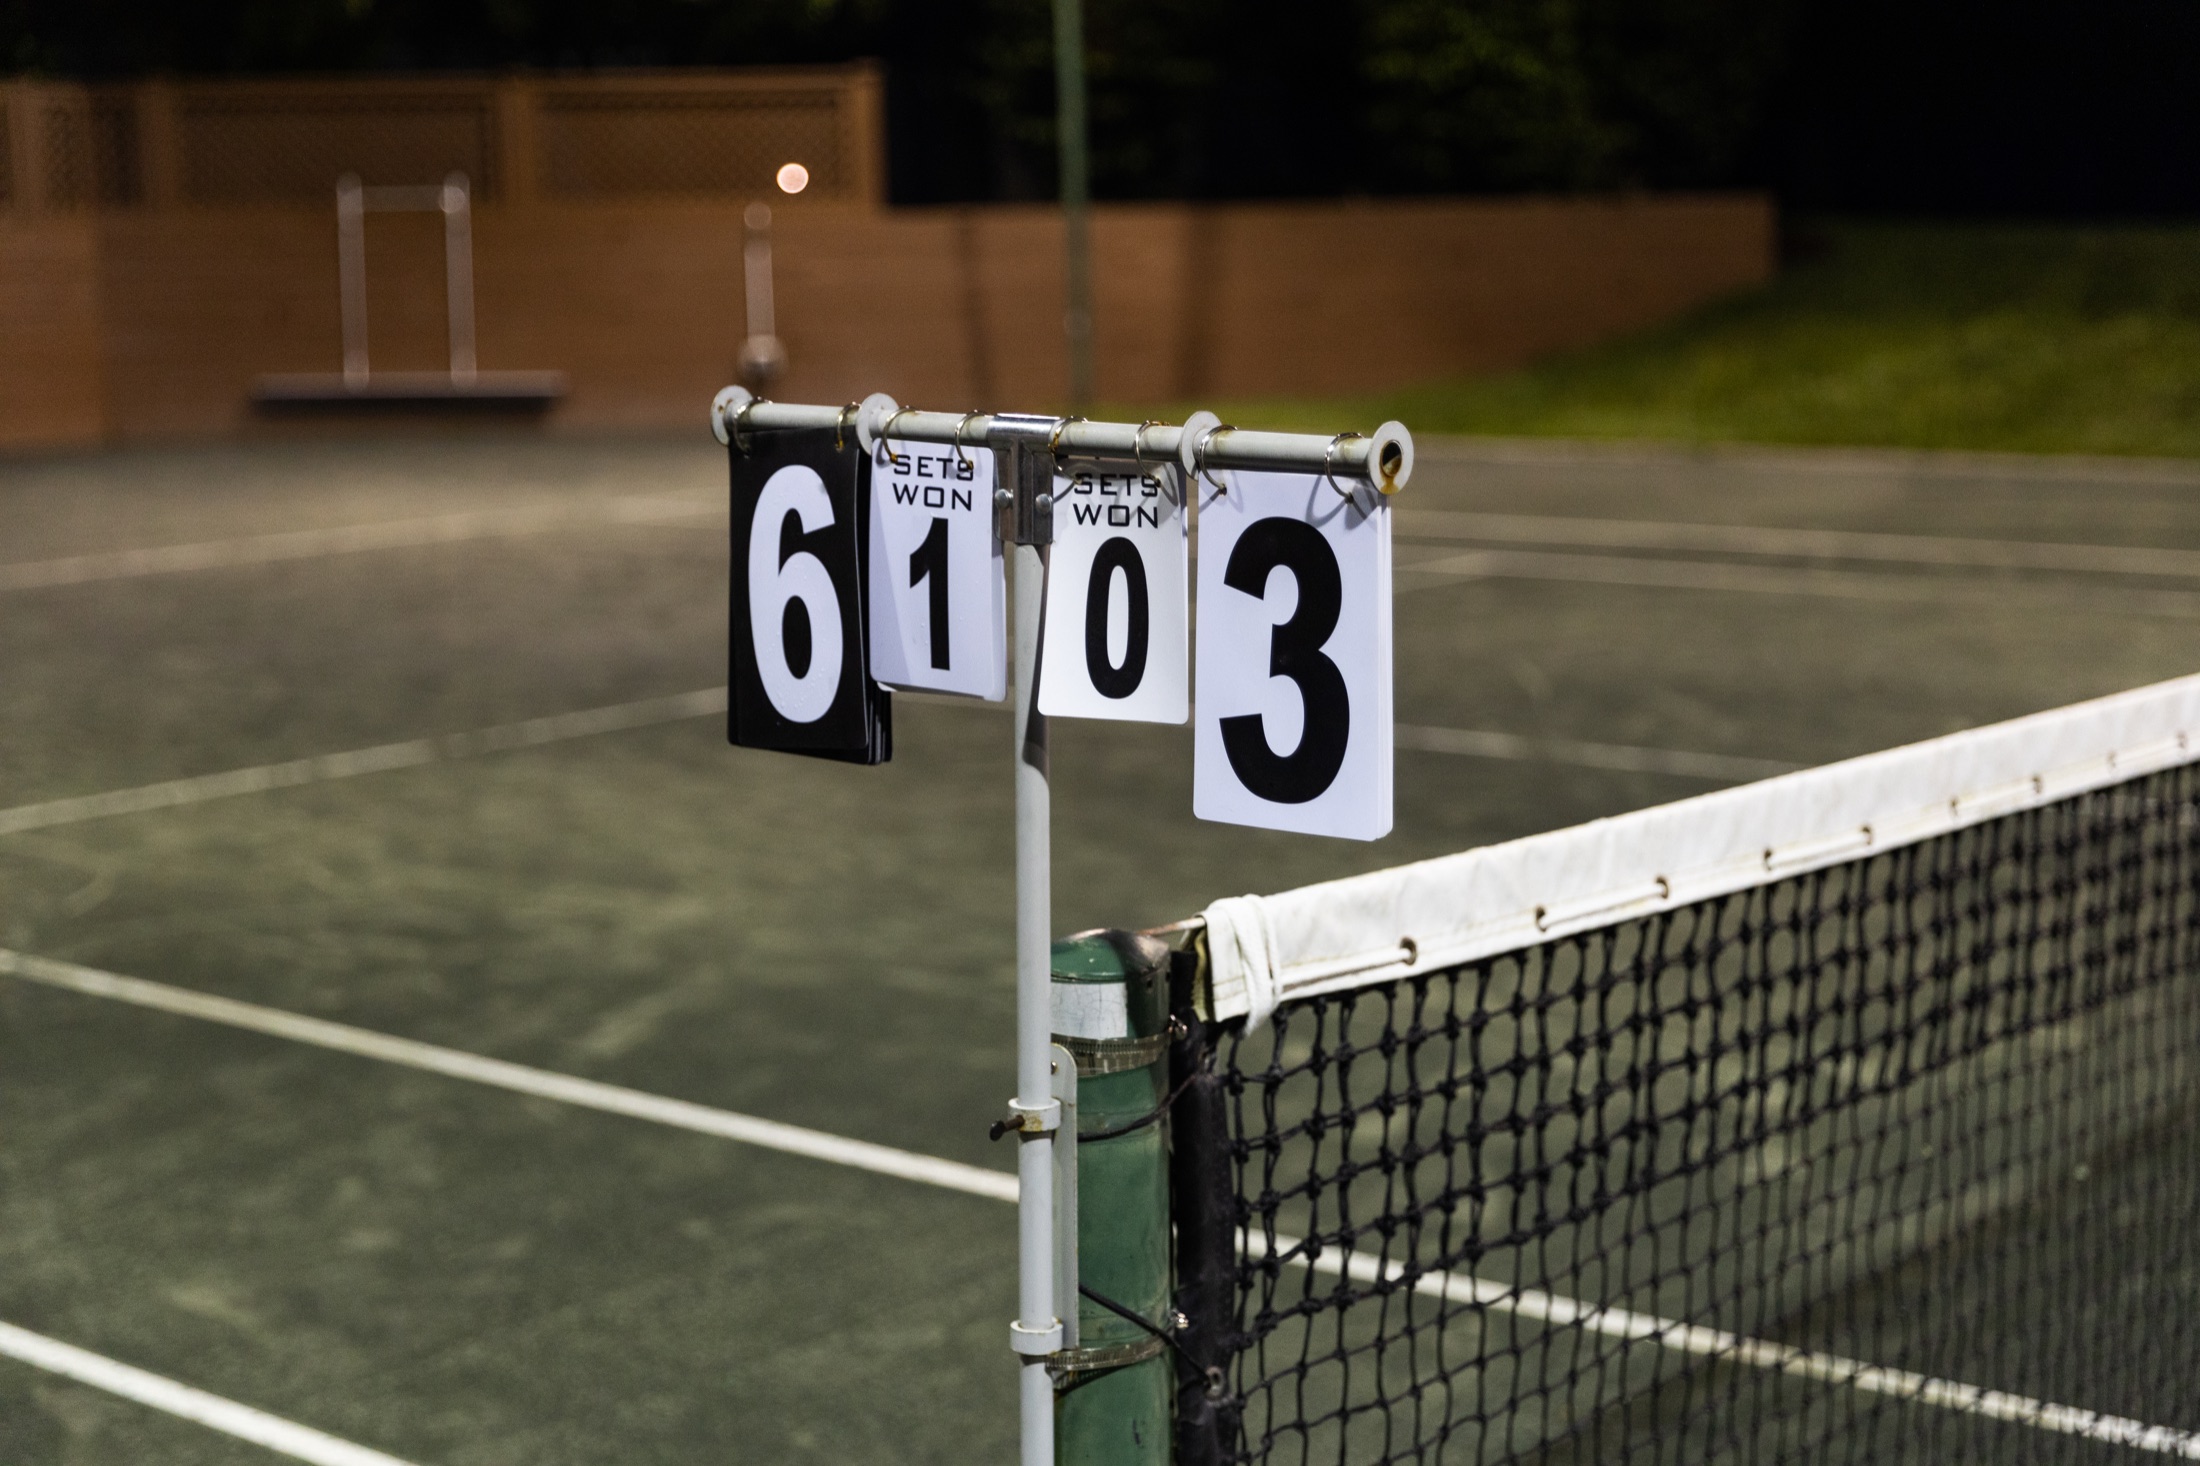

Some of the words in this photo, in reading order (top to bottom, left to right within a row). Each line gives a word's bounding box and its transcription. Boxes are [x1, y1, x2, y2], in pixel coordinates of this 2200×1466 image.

[892, 482, 973, 512] WON
[893, 454, 974, 482] SETS
[1074, 472, 1159, 498] SETS
[1073, 503, 1159, 529] WON
[748, 464, 843, 724] 6
[909, 517, 950, 671] 1
[1085, 536, 1149, 700] 0
[1219, 516, 1350, 804] 3
